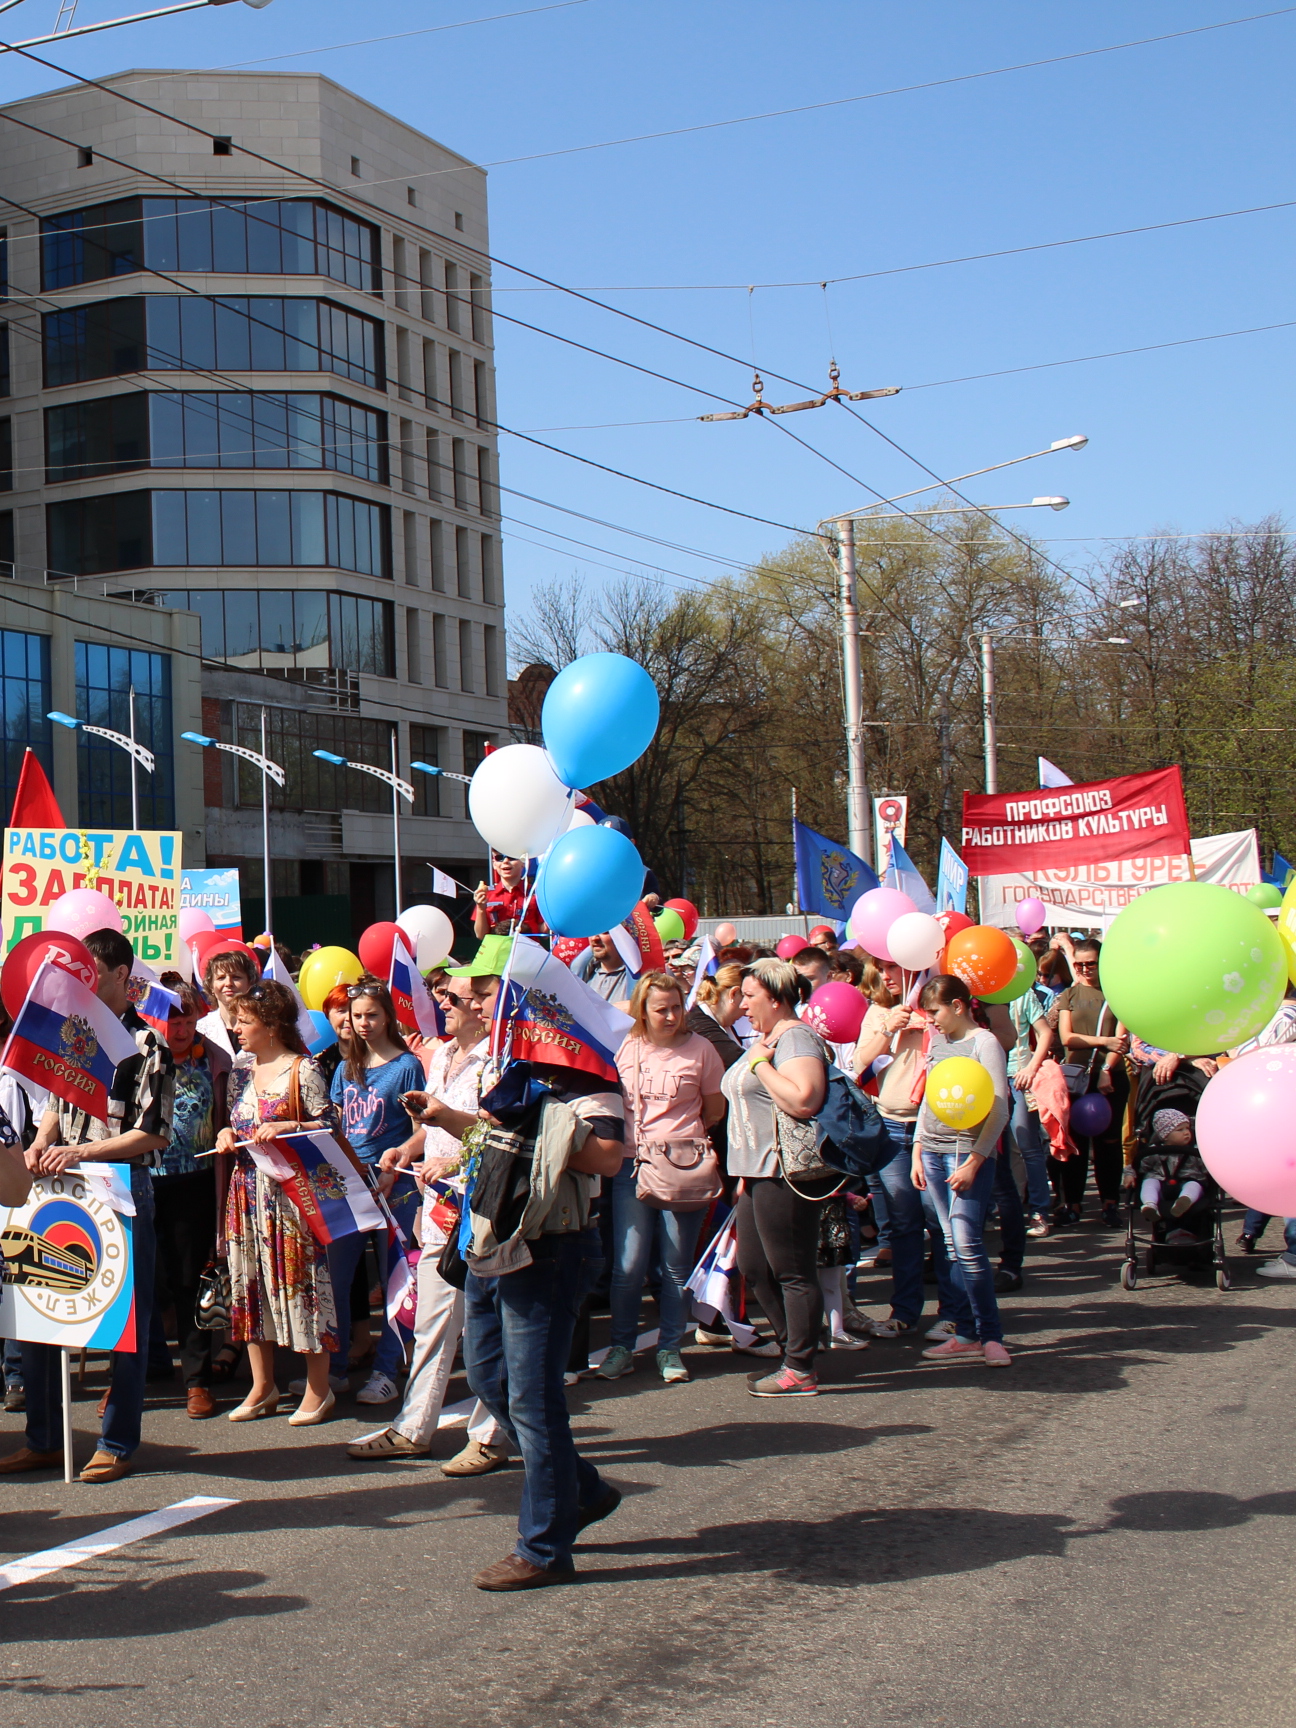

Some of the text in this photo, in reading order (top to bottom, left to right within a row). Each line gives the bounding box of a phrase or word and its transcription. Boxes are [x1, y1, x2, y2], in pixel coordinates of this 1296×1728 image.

[961, 804, 1169, 847] РАБОТНИКОВ КУЛЬТУРЫ
[1005, 789, 1113, 821] ПРОФСОЮЗ
[9, 831, 175, 880] РАБОТА!
[942, 844, 964, 894] МИР
[180, 893, 230, 908] ДИНЫ
[514, 1026, 582, 1056] РОССИЯ
[32, 1052, 97, 1096] РОССИЯ
[289, 1161, 317, 1217] РОССИЯ
